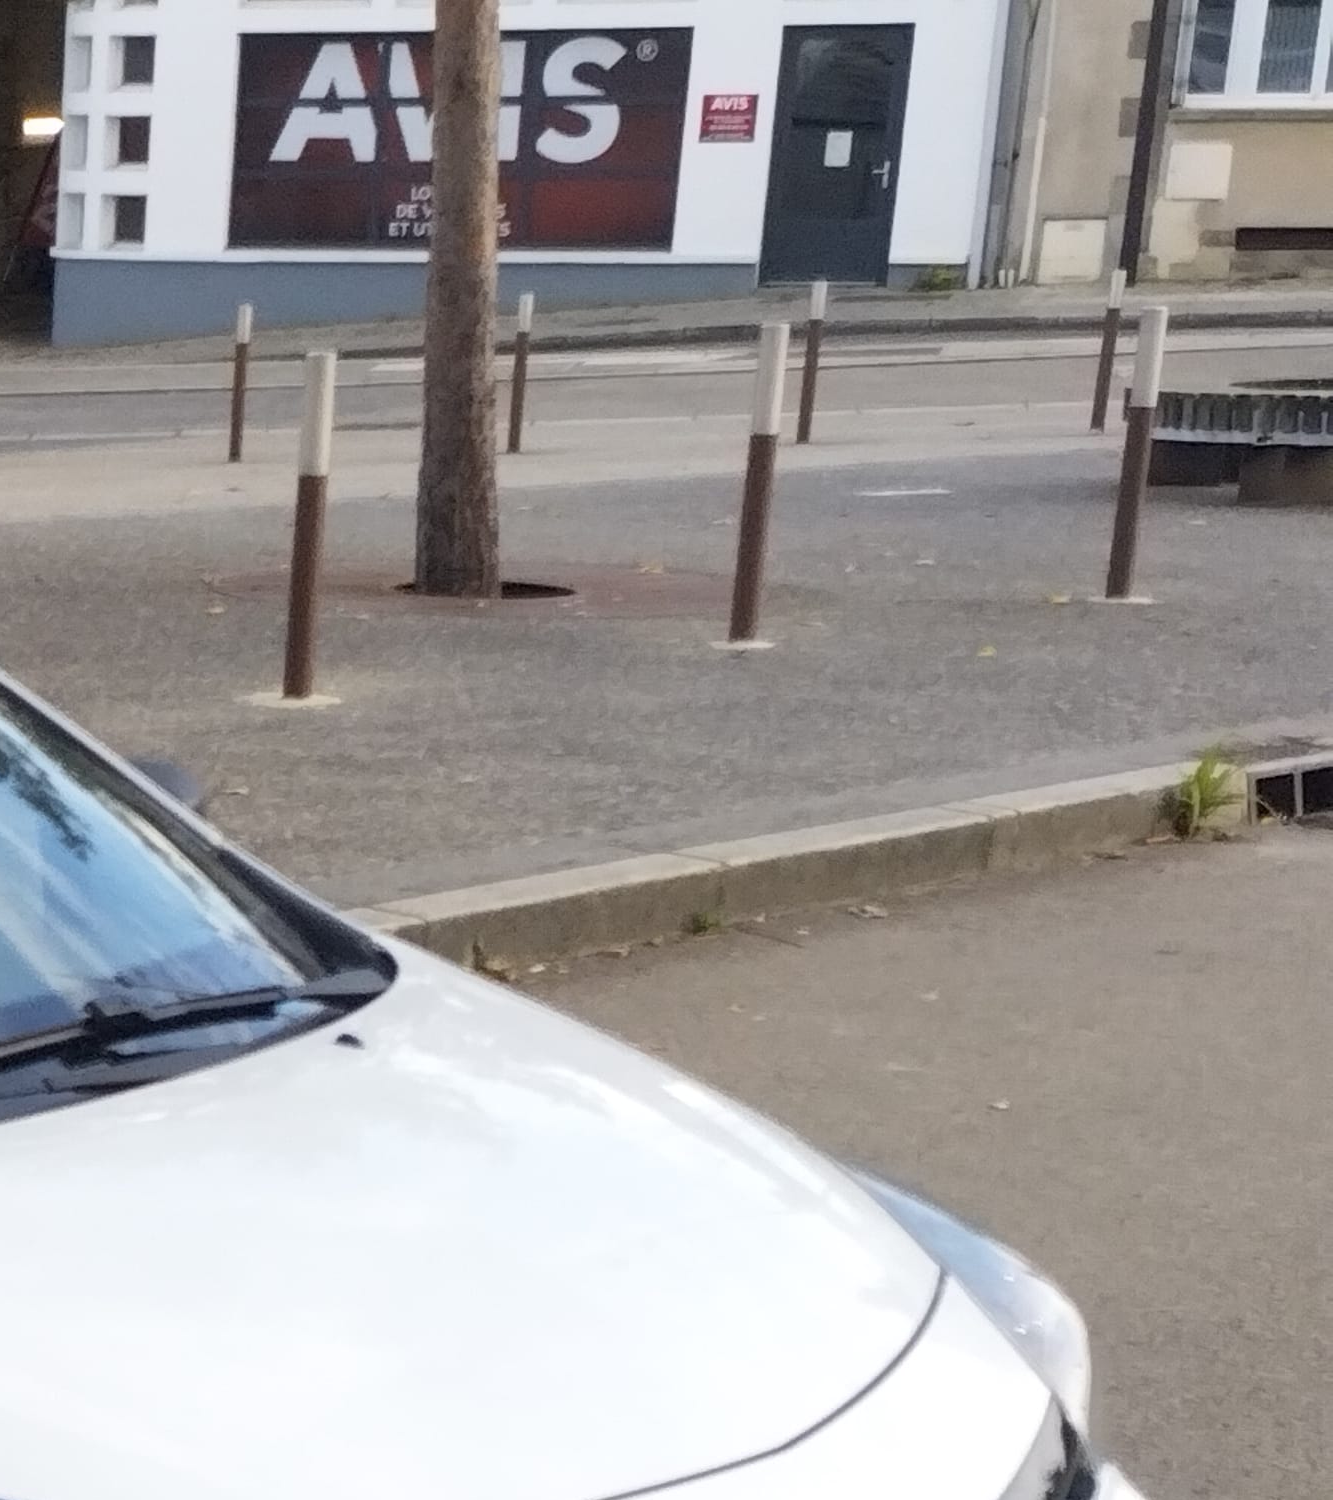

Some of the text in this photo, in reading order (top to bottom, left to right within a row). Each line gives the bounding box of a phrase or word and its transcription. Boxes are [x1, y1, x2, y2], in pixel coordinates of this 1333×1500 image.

[709, 96, 750, 112] AVIS
[395, 203, 418, 219] DE
[388, 222, 410, 237] ET
